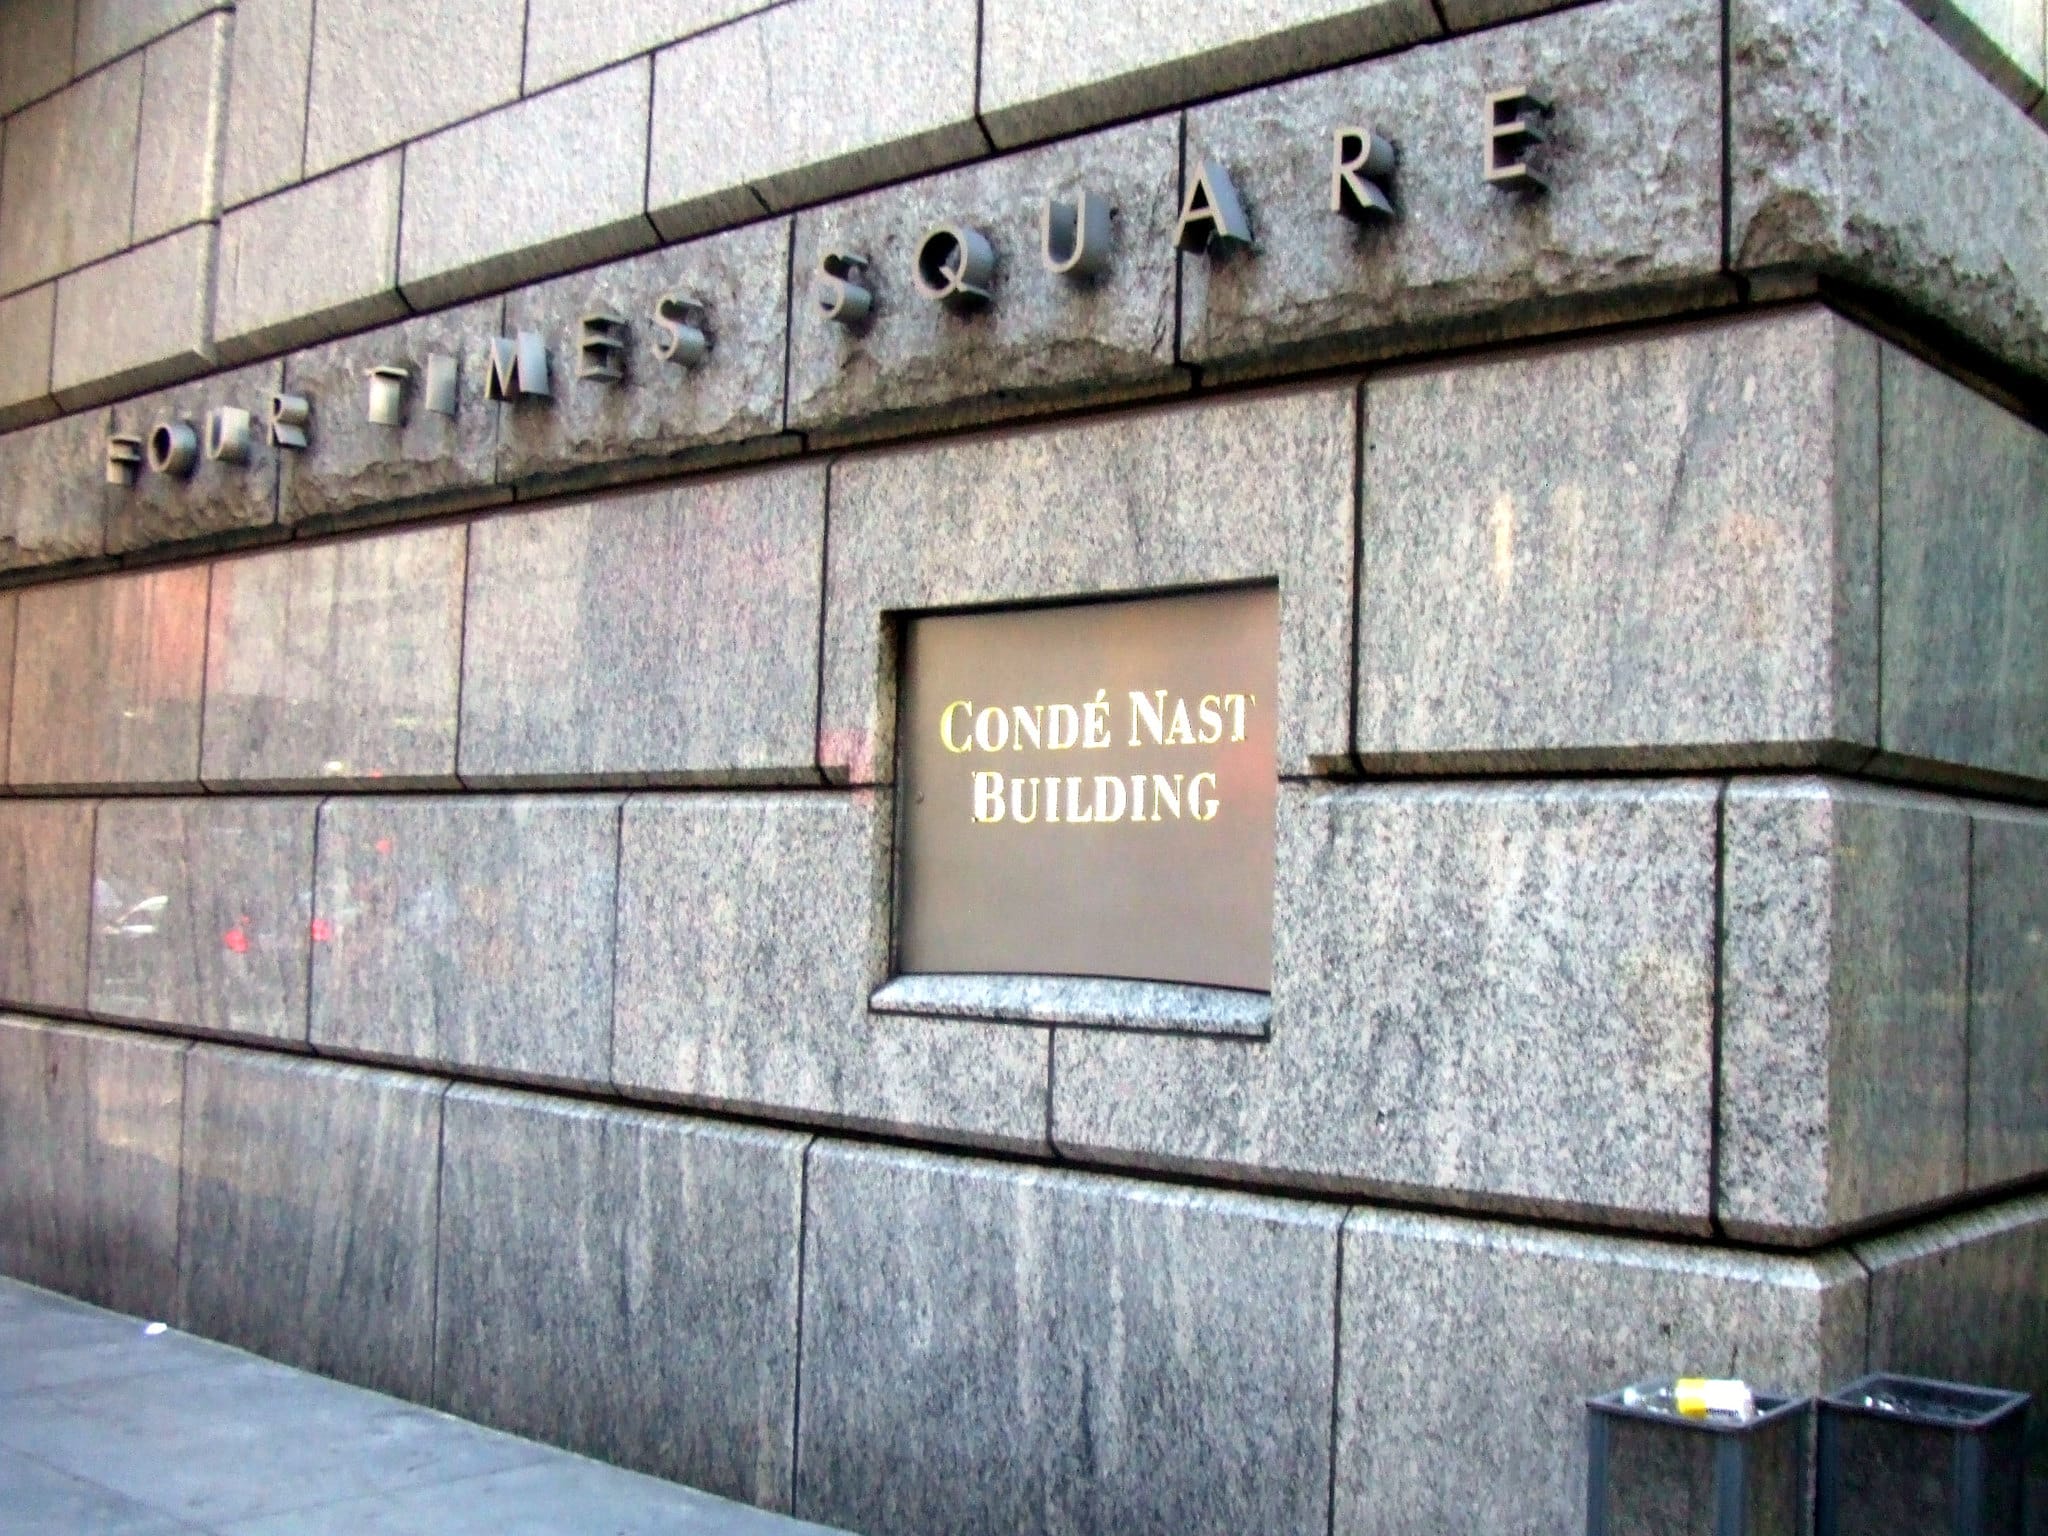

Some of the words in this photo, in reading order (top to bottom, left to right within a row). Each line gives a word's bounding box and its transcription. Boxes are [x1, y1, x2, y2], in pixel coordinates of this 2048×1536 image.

[106, 395, 309, 485] FOUR
[364, 296, 708, 424] TIMES
[815, 86, 1551, 322] SQUARE
[940, 688, 1111, 753] CONDÉ
[1128, 689, 1256, 747] NAST
[972, 771, 1220, 824] BUILDING
